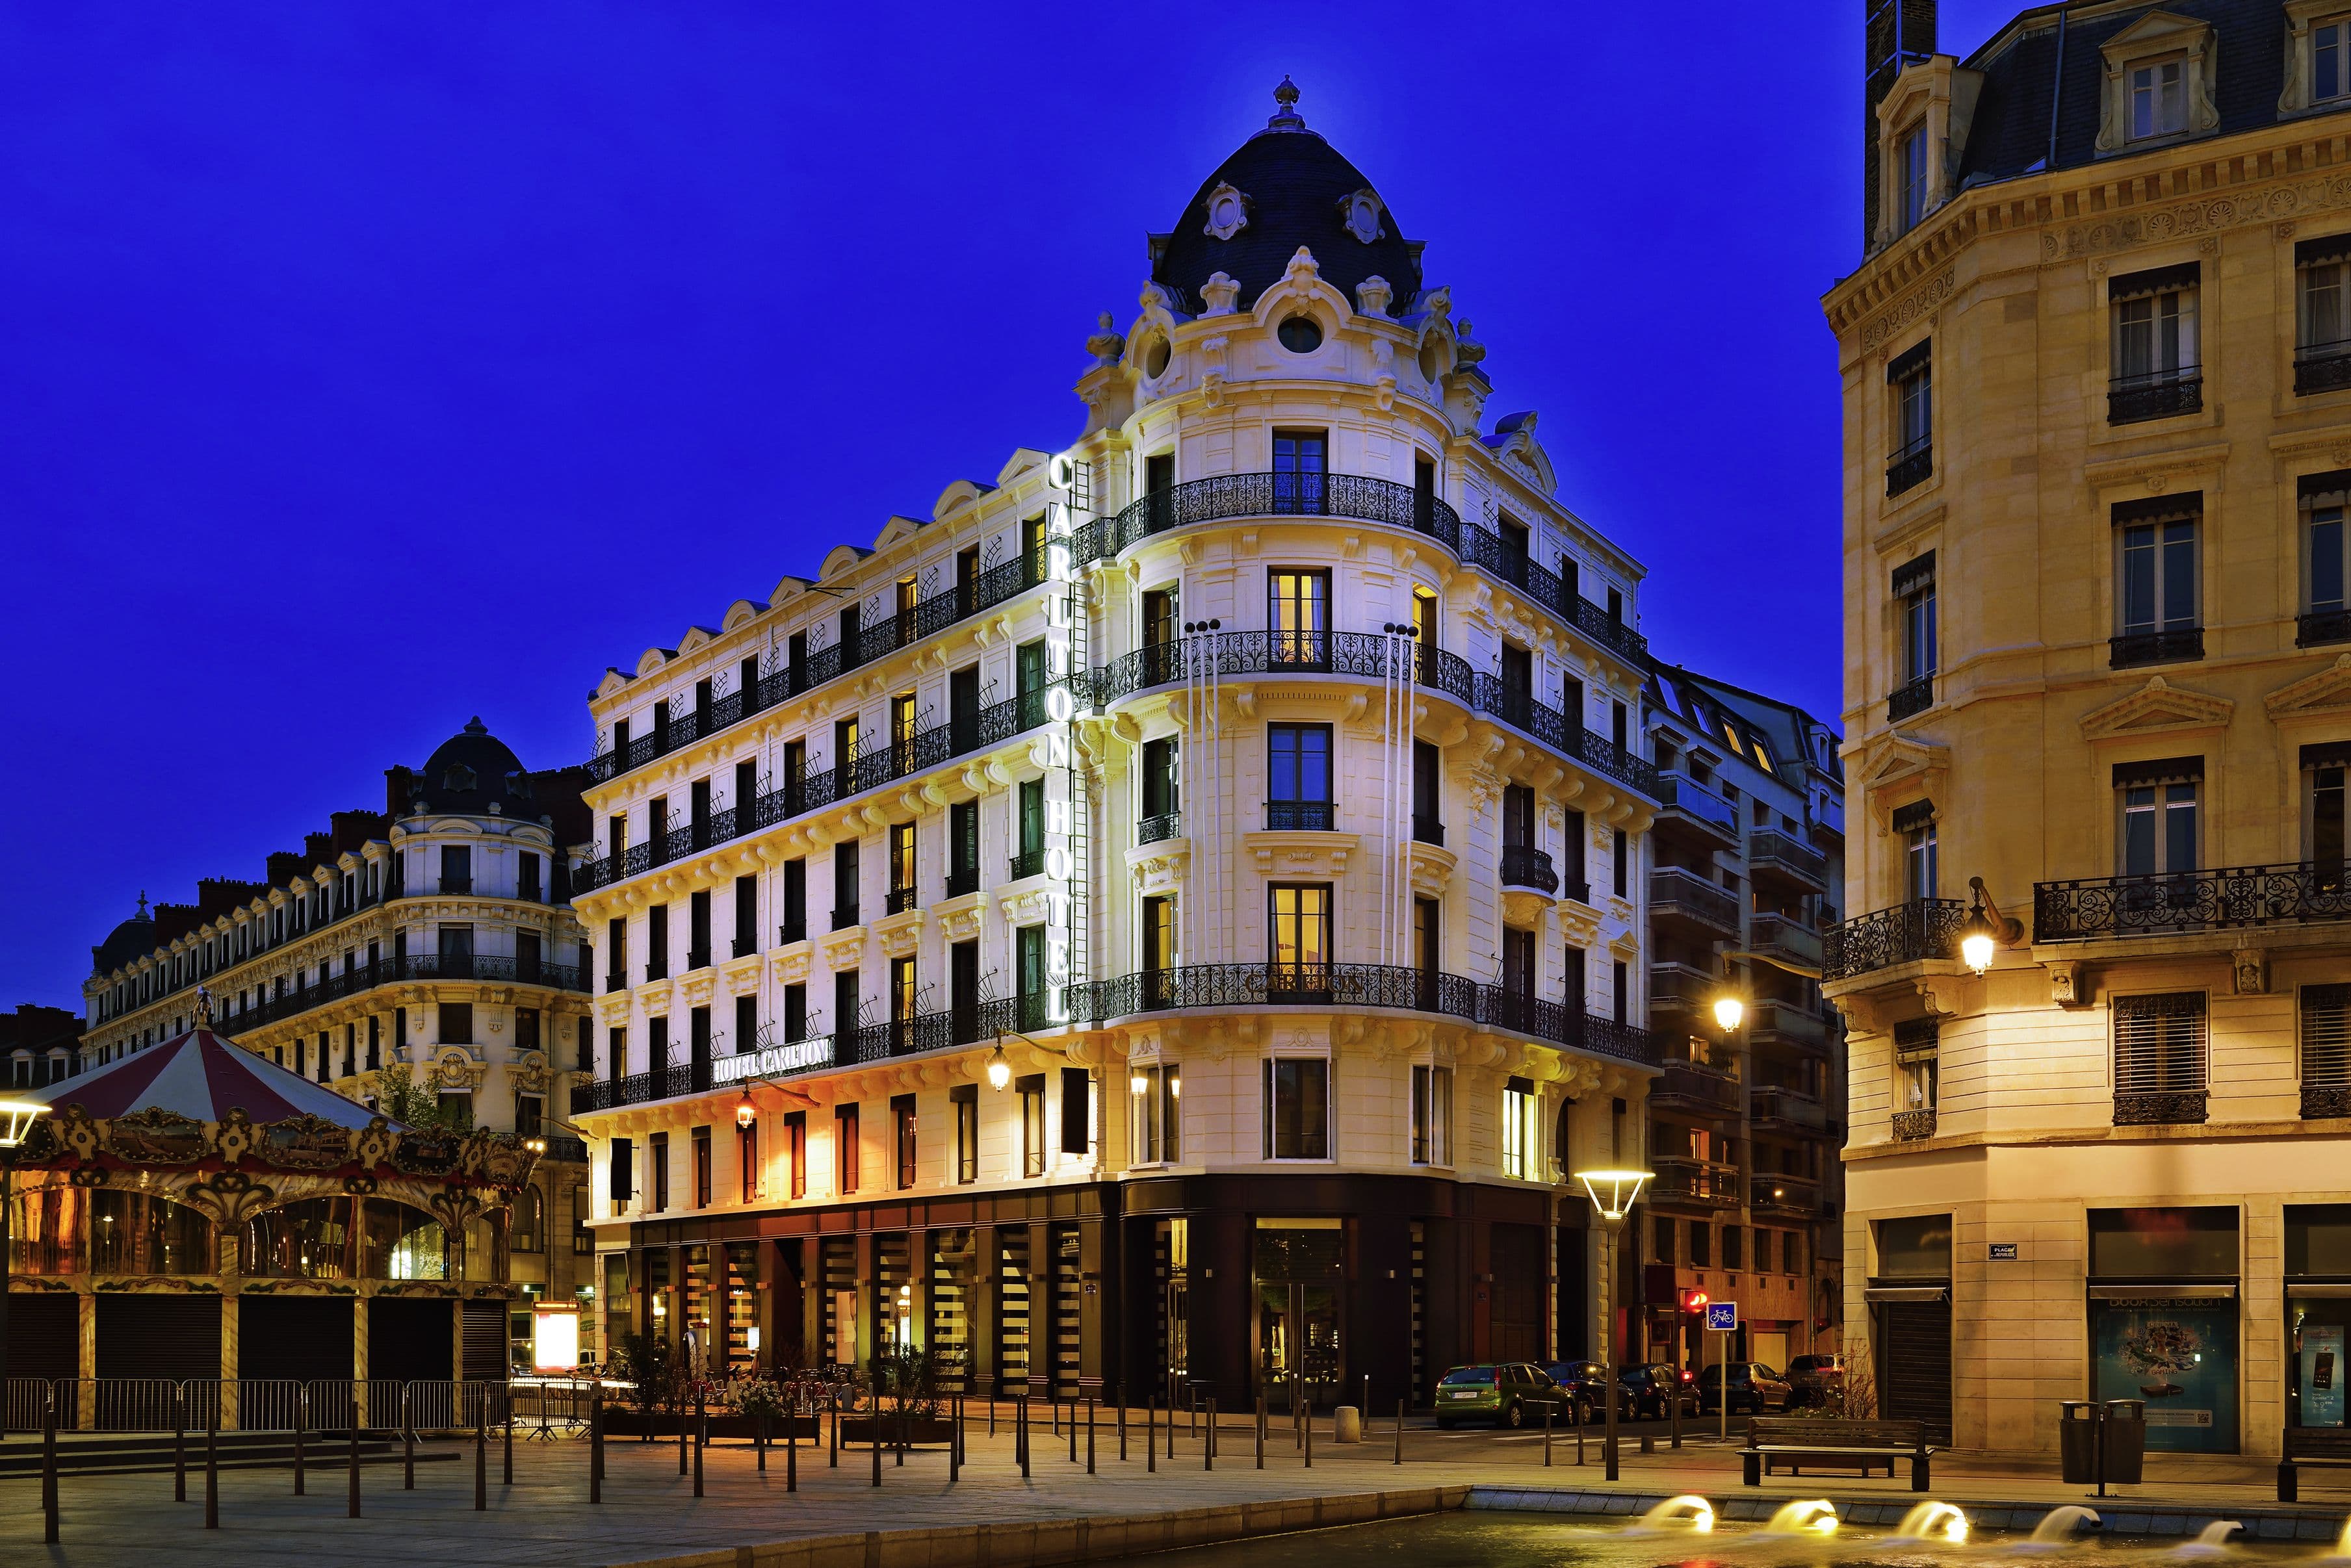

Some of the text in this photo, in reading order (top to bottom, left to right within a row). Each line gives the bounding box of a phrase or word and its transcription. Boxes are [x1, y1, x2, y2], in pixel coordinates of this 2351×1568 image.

[1044, 454, 1072, 1022] CARLTON HOTEL
[713, 1038, 830, 1083] HOTEL CARLTON
